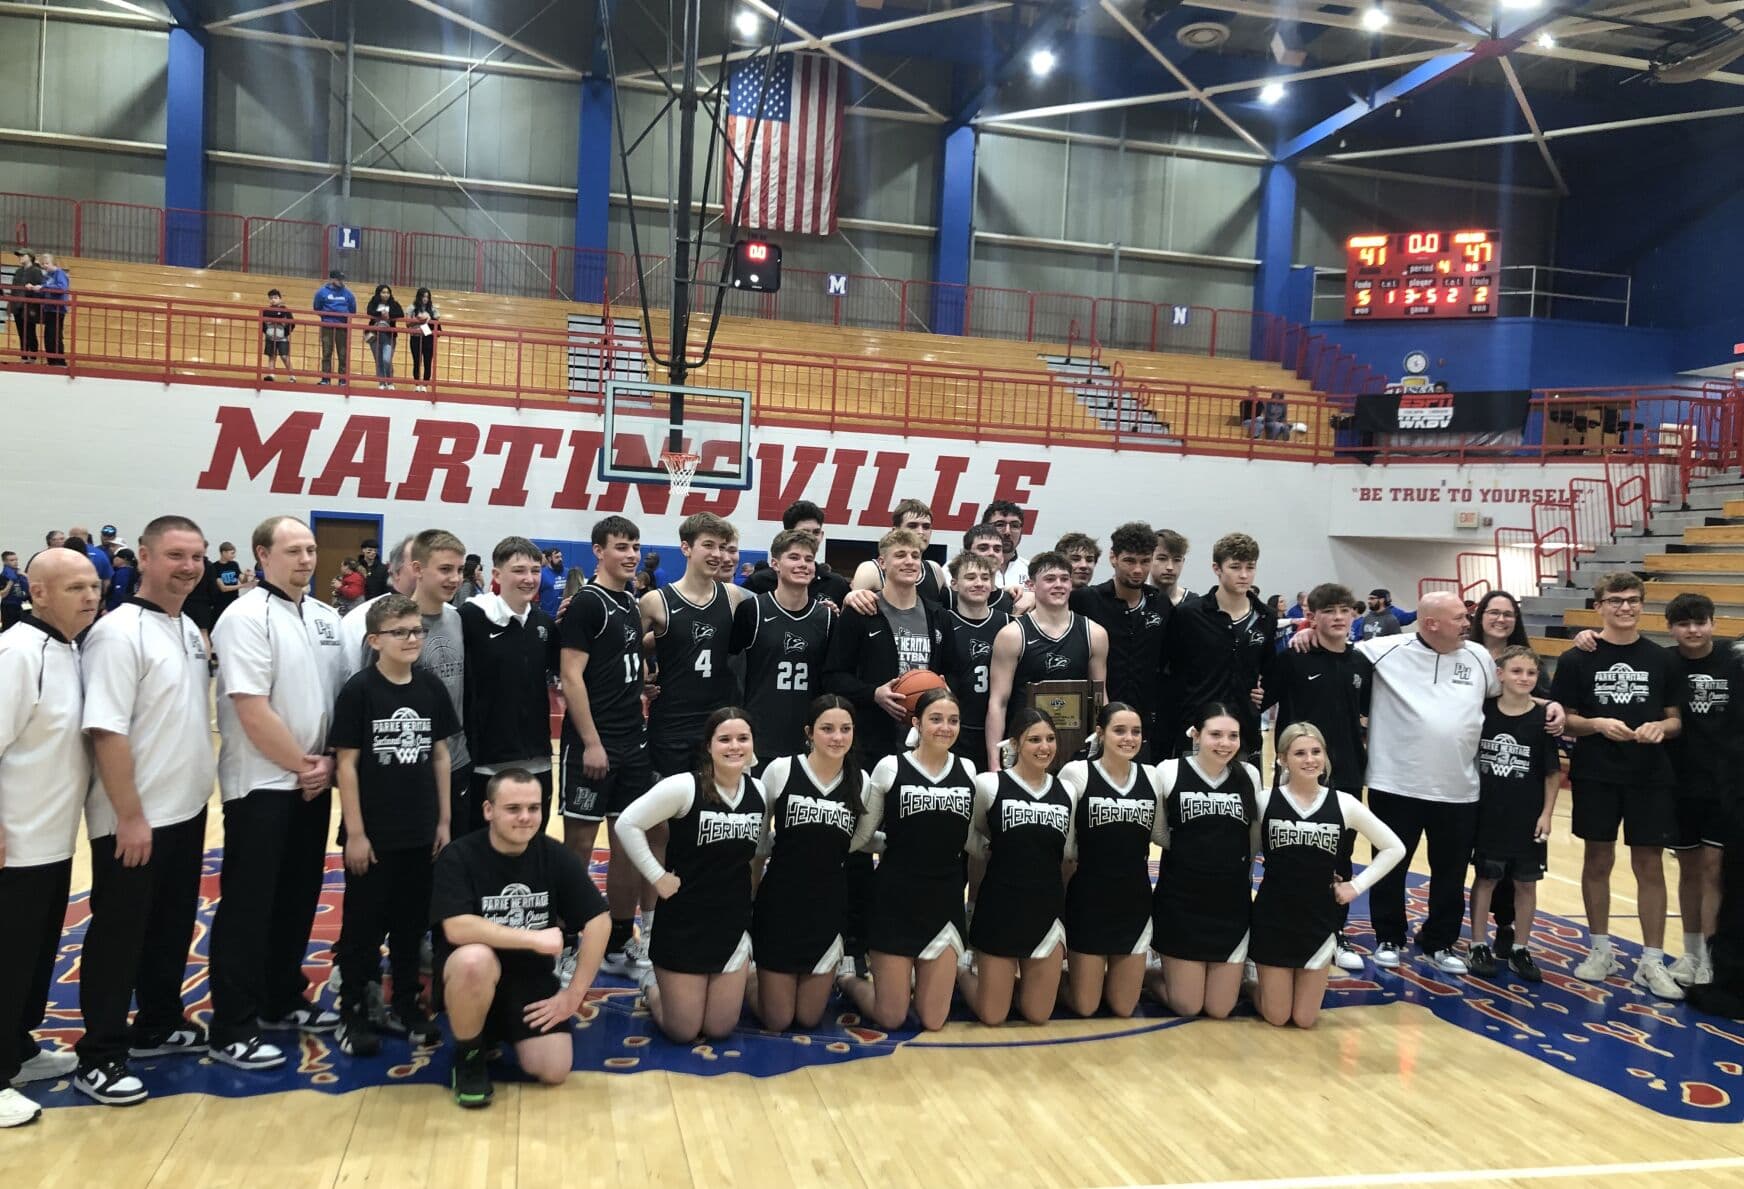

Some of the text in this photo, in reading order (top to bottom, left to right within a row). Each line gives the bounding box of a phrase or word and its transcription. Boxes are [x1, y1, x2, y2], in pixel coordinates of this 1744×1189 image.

[343, 228, 355, 248] L
[1409, 234, 1439, 254] 0.0
[1359, 247, 1386, 266] 41
[1465, 242, 1492, 262] 47
[1409, 260, 1451, 274] period 4
[829, 275, 846, 294] M
[1358, 289, 1371, 305] 5
[1447, 288, 1459, 303] 2
[1476, 286, 1488, 302] 2
[1173, 306, 1187, 324] N
[196, 405, 1050, 535] MARTINSVILLE
[1389, 488, 1441, 502] TRUE
[1447, 488, 1473, 503] TO
[624, 653, 640, 683] 11
[694, 649, 712, 678] 4
[1454, 663, 1471, 680] PH
[777, 661, 808, 691] 22
[974, 665, 988, 693] 3
[372, 721, 401, 733] PARKE
[574, 786, 598, 810] PH
[900, 792, 971, 820] HERITAGE
[785, 802, 856, 837] HERITAGE
[1002, 806, 1070, 838] HERITAGE
[1089, 804, 1155, 831] HERITAGE
[697, 819, 762, 846] HERITAG
[1269, 826, 1340, 855] HERITAGE
[482, 898, 509, 912] PARKE
